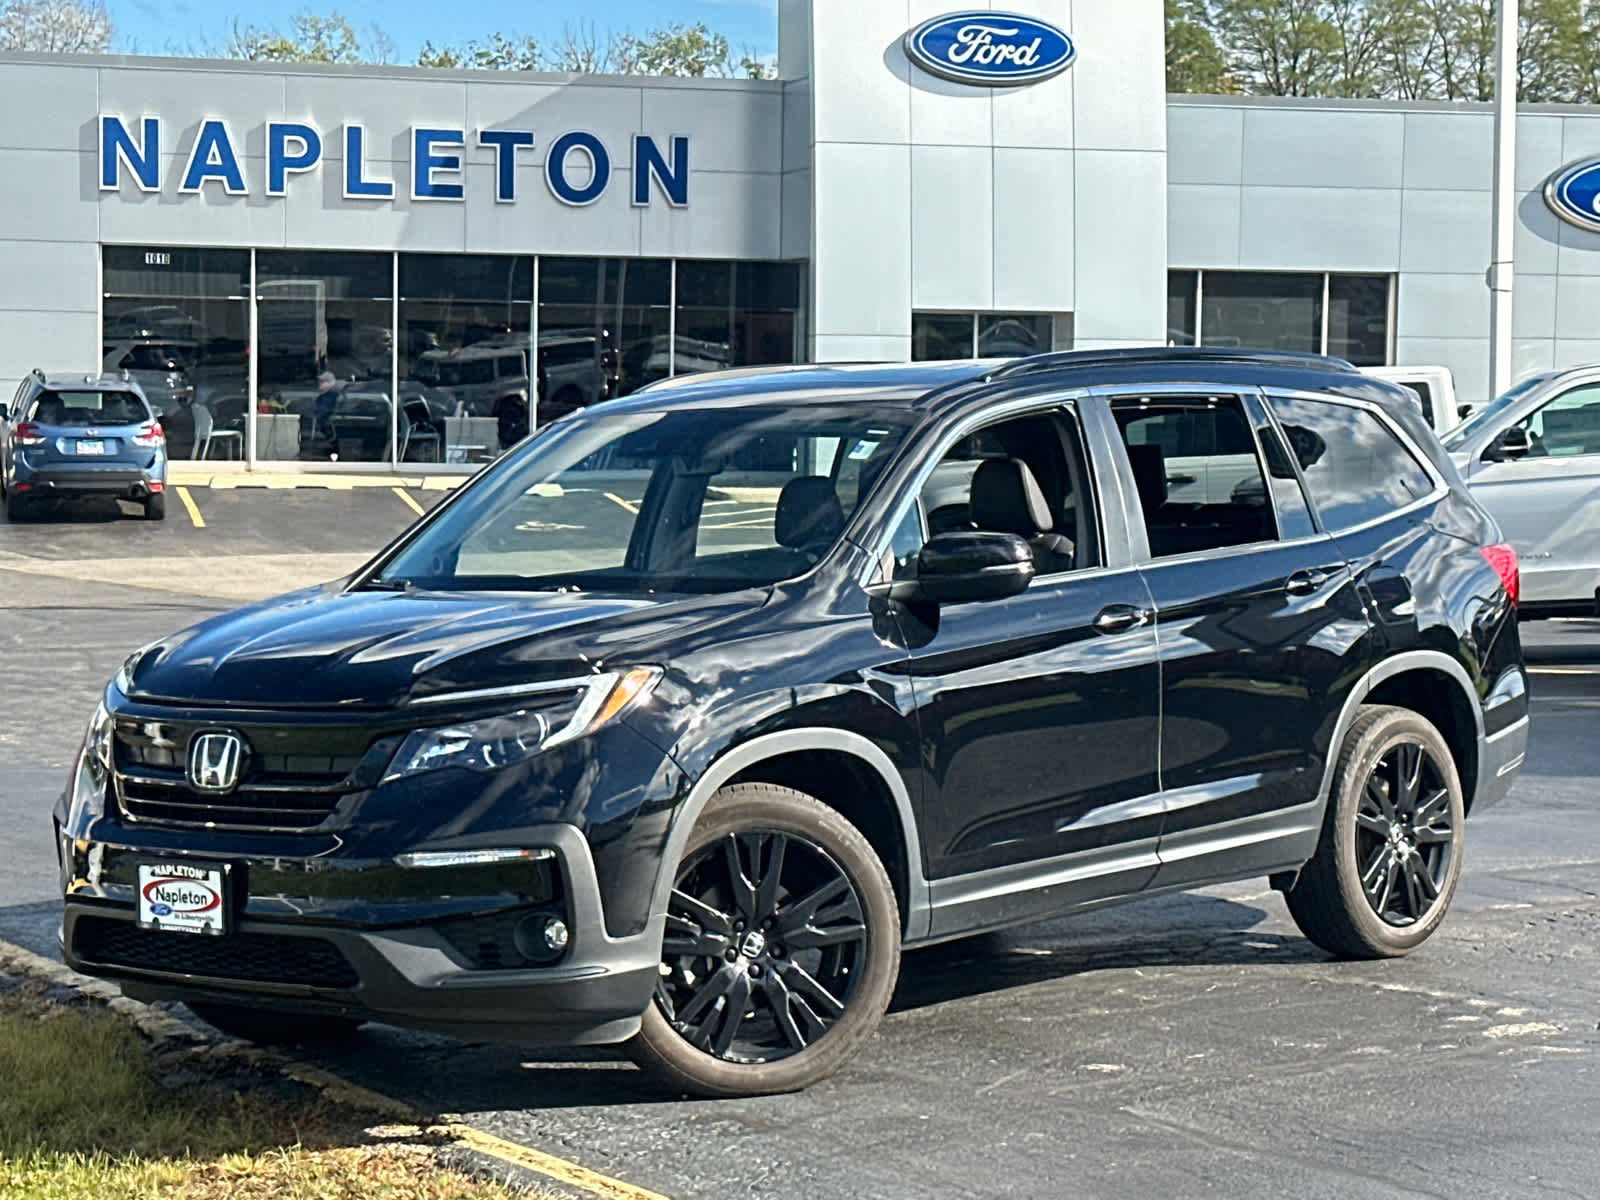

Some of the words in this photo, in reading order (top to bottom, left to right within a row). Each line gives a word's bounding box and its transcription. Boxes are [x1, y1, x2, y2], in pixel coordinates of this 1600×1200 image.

[948, 24, 1042, 66] Ford
[99, 114, 690, 208] NAPLETON
[155, 886, 207, 906] Napleton
